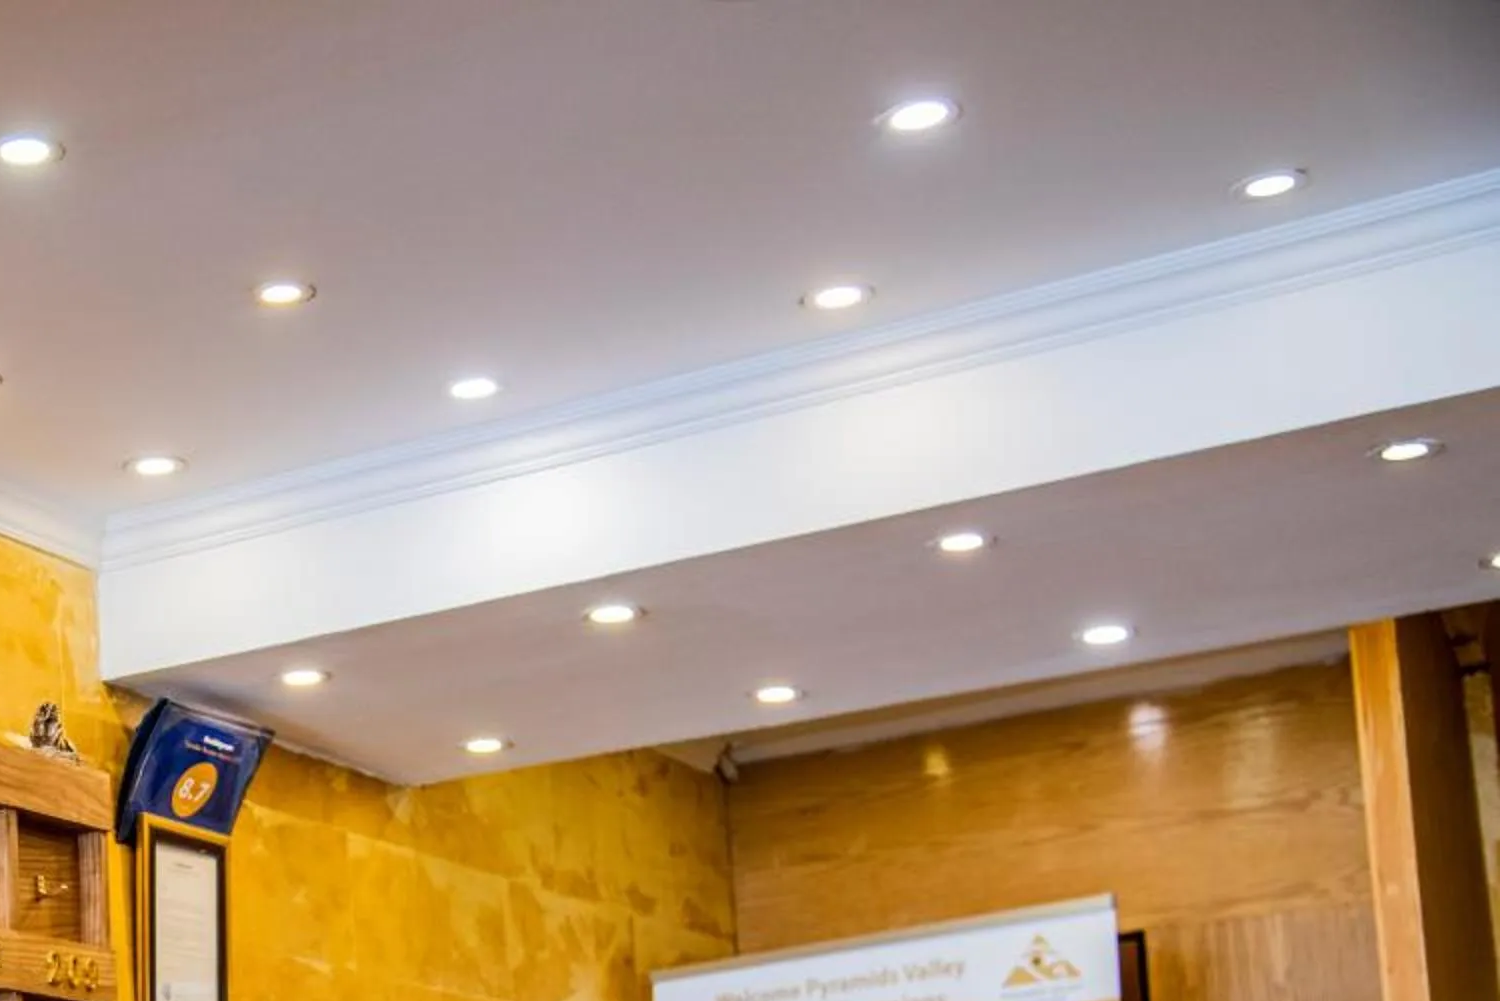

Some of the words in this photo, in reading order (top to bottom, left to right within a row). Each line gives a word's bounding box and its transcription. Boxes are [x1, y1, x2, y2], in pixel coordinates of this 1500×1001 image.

[178, 776, 211, 803] 8.7
[46, 949, 99, 992] 209
[805, 962, 899, 999] Pyramids
[900, 955, 966, 984] Valley
